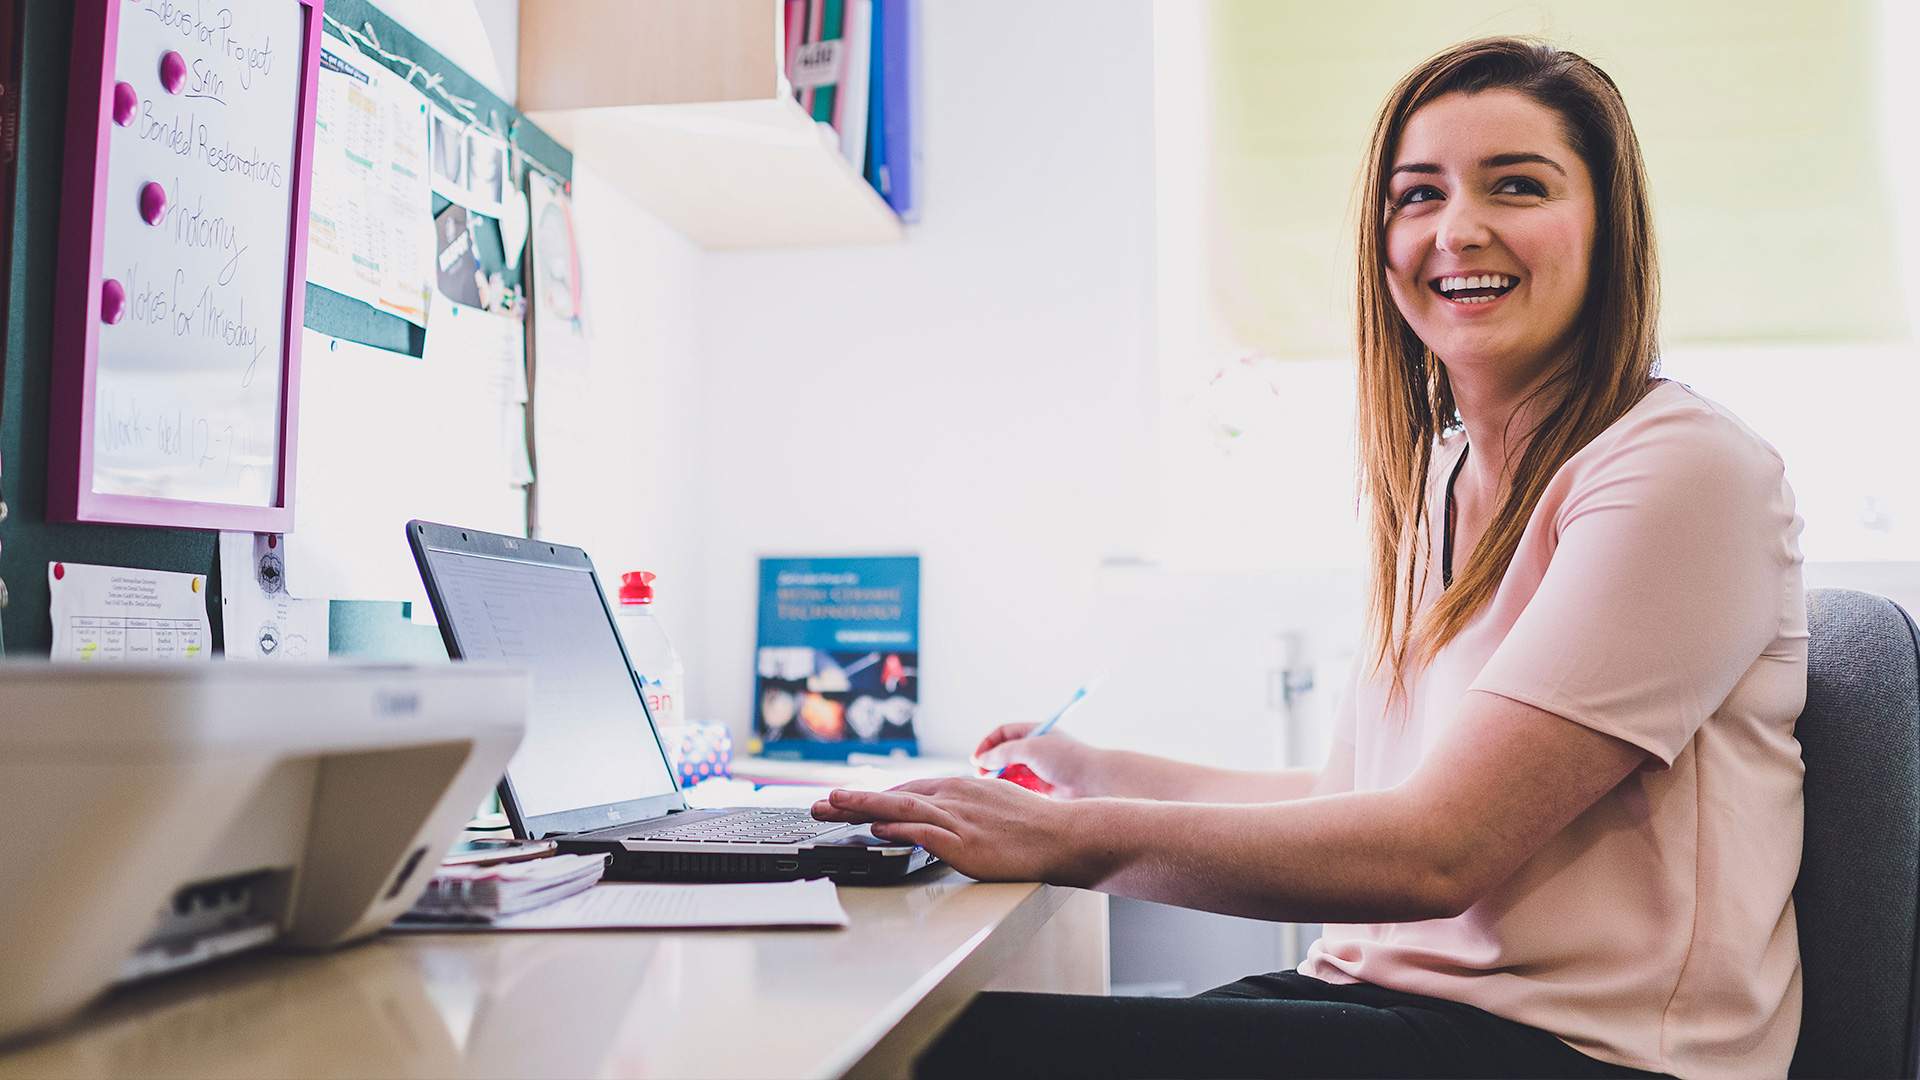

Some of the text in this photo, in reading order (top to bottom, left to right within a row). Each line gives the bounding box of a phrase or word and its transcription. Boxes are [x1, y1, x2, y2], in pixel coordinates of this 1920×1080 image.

[217, 8, 272, 90] Project
[139, 99, 194, 157] Bonded
[165, 176, 248, 287] Anatomy
[126, 261, 168, 325] Notes
[171, 268, 197, 337] for
